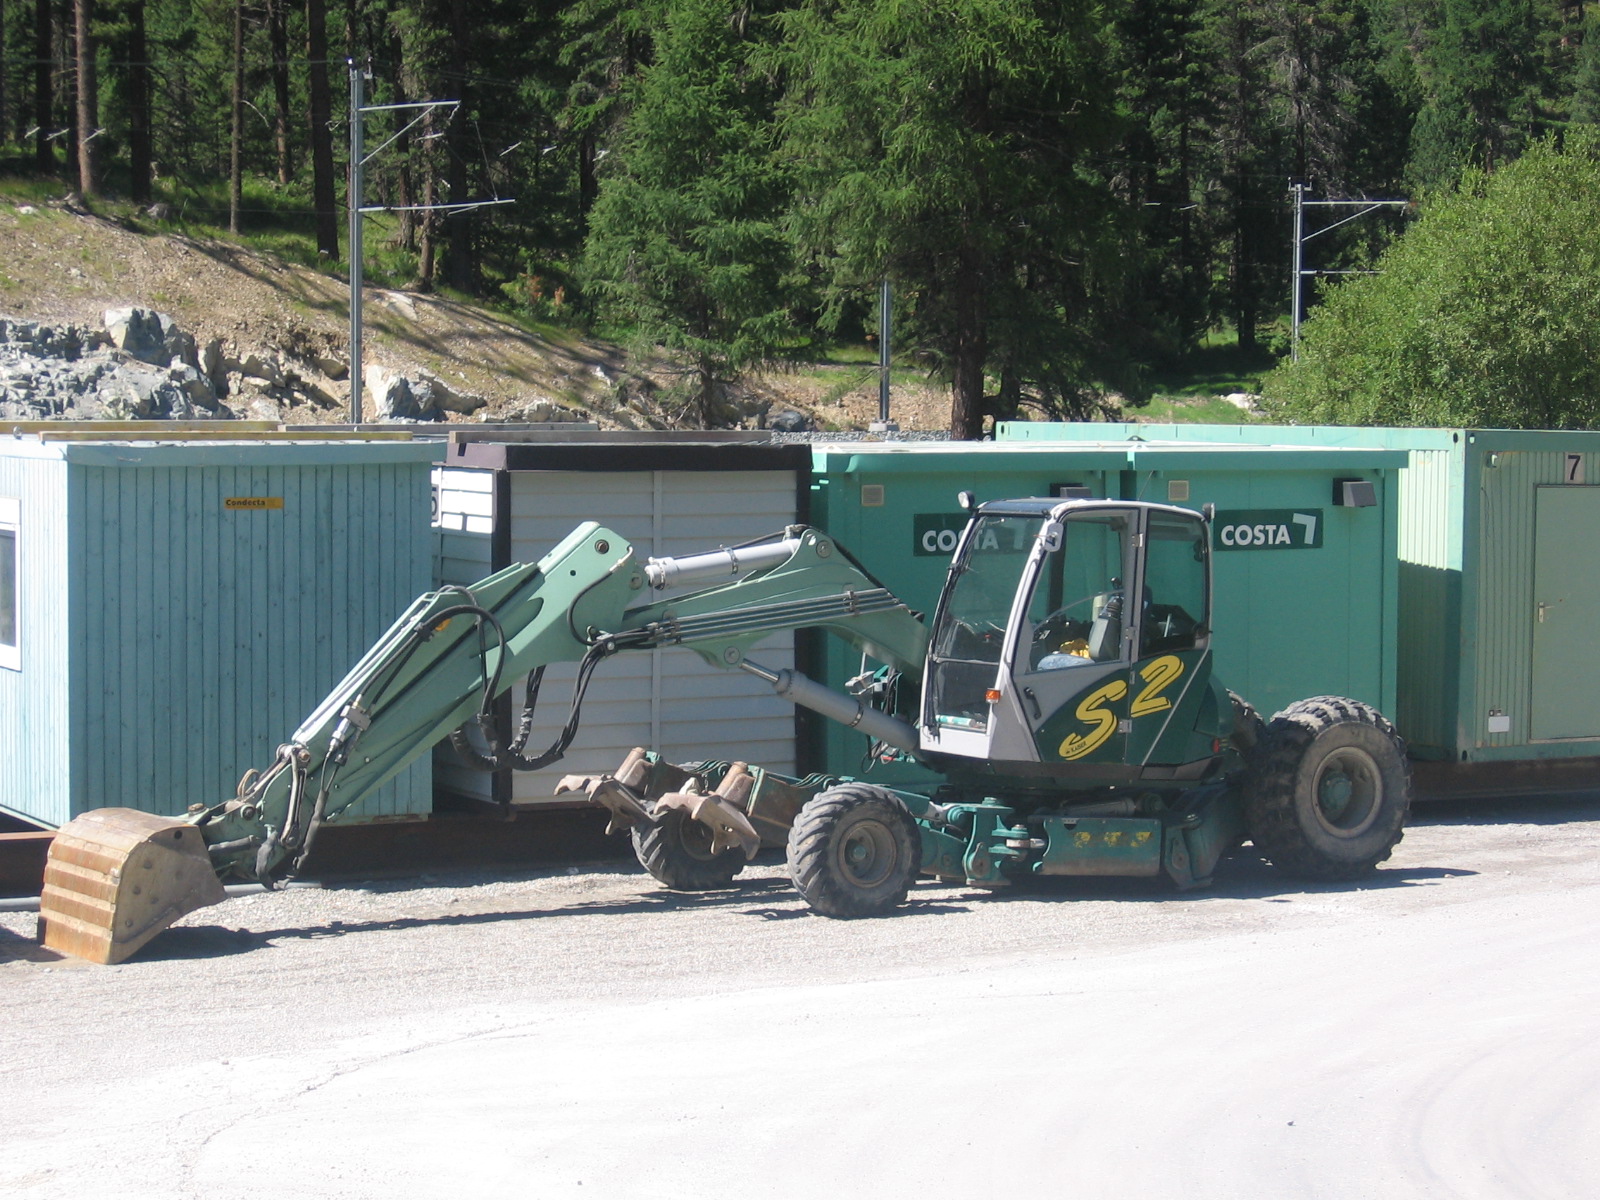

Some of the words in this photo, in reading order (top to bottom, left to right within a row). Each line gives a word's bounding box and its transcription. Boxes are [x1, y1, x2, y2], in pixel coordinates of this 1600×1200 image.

[1567, 454, 1581, 481] 7
[922, 529, 999, 552] COTA
[1220, 524, 1291, 546] COSTA
